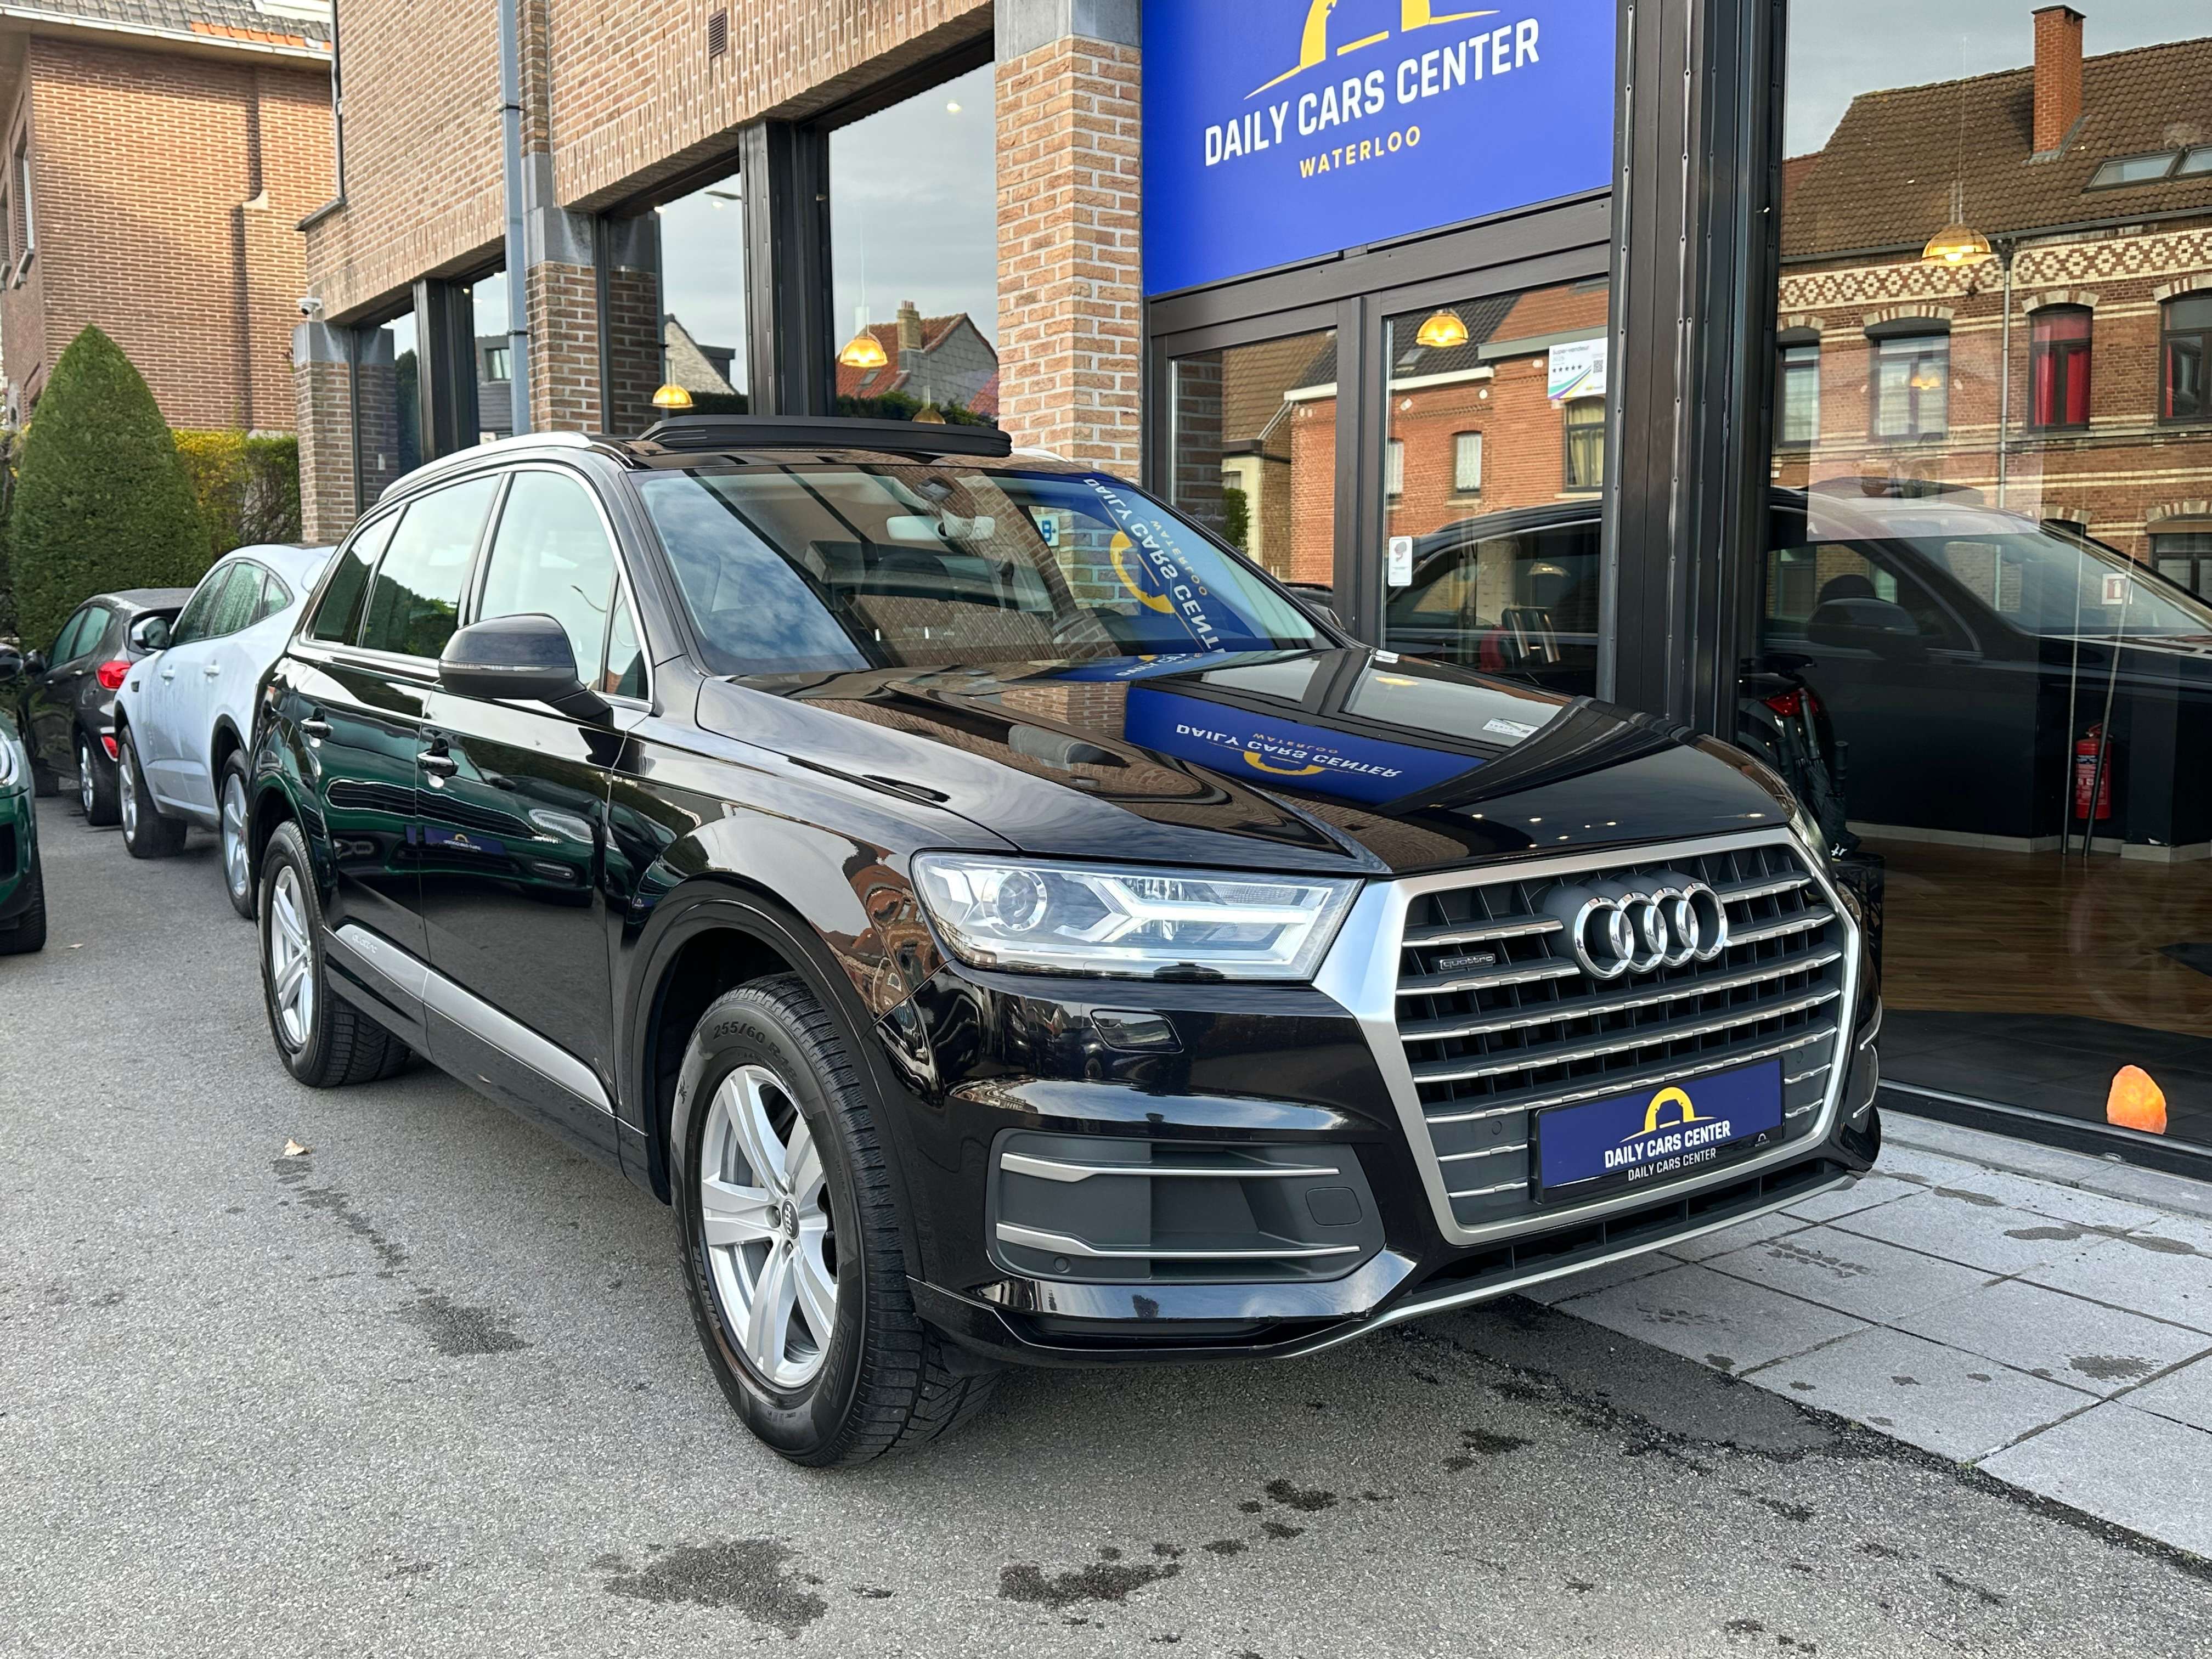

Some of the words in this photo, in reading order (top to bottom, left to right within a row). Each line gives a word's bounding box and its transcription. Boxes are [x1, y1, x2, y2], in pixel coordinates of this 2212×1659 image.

[1205, 101, 1289, 166] DAILY
[1297, 70, 1385, 136] CARS
[1397, 18, 1539, 104] CENTER
[1300, 126, 1420, 178] WATERLOO
[1443, 956, 1493, 969] quattro
[713, 1022, 765, 1043] 255/60
[1604, 1142, 1644, 1168] DAILY
[1647, 1132, 1681, 1156] CARS
[1685, 1120, 1731, 1147] CENTER
[1628, 1164, 1656, 1181] DAILY
[1657, 1156, 1680, 1173] CARS
[1683, 1148, 1717, 1166] CENTER
